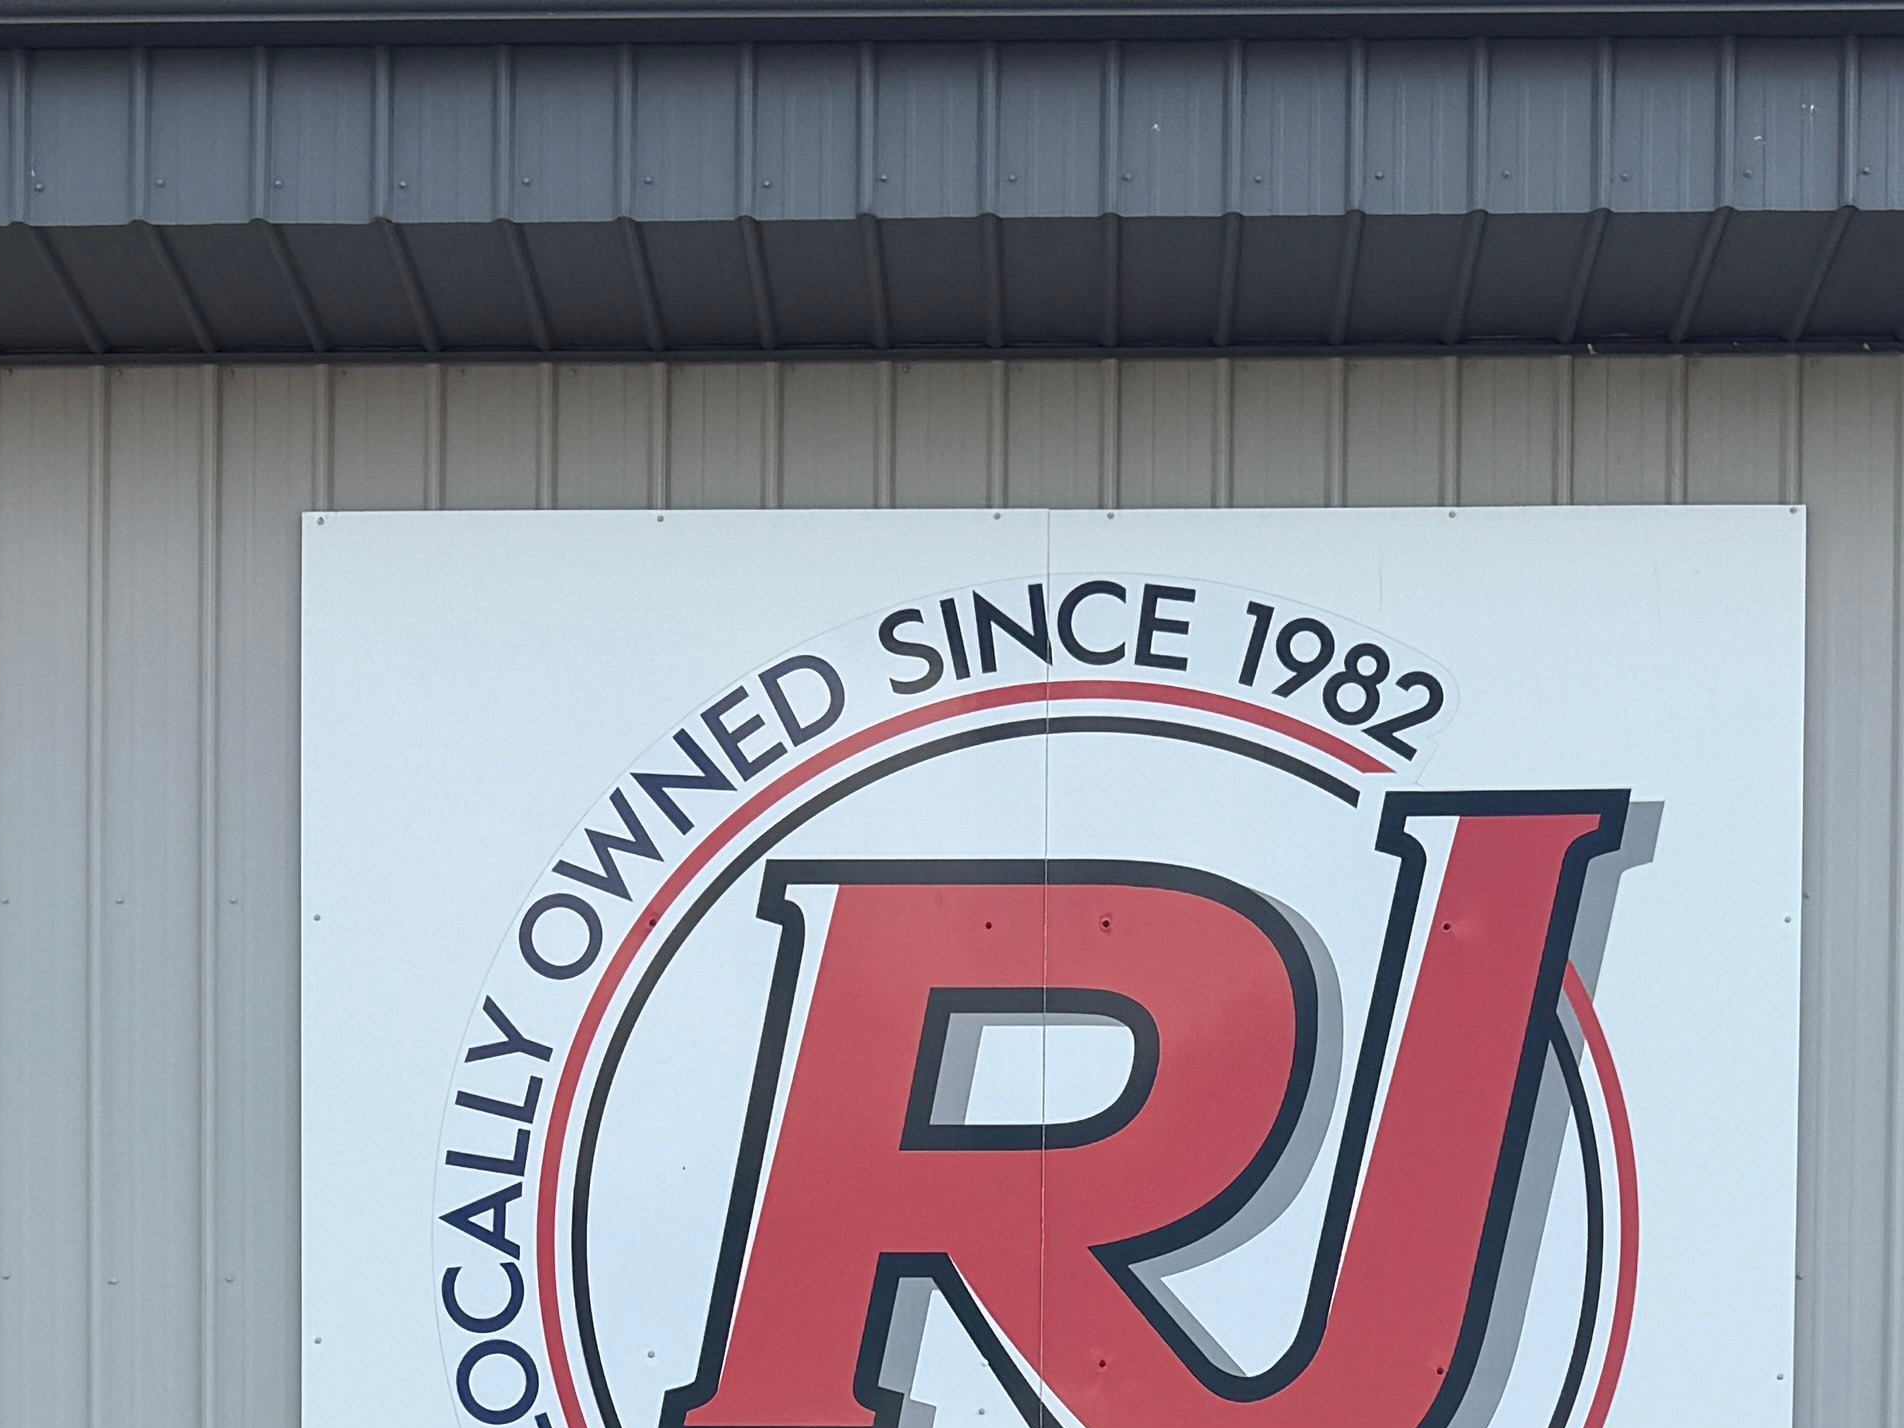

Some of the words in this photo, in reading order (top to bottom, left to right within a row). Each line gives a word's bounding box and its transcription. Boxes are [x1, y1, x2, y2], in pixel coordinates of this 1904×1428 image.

[518, 654, 846, 981] OWNED
[878, 580, 1197, 695] SINCE
[1238, 600, 1444, 762] 1982
